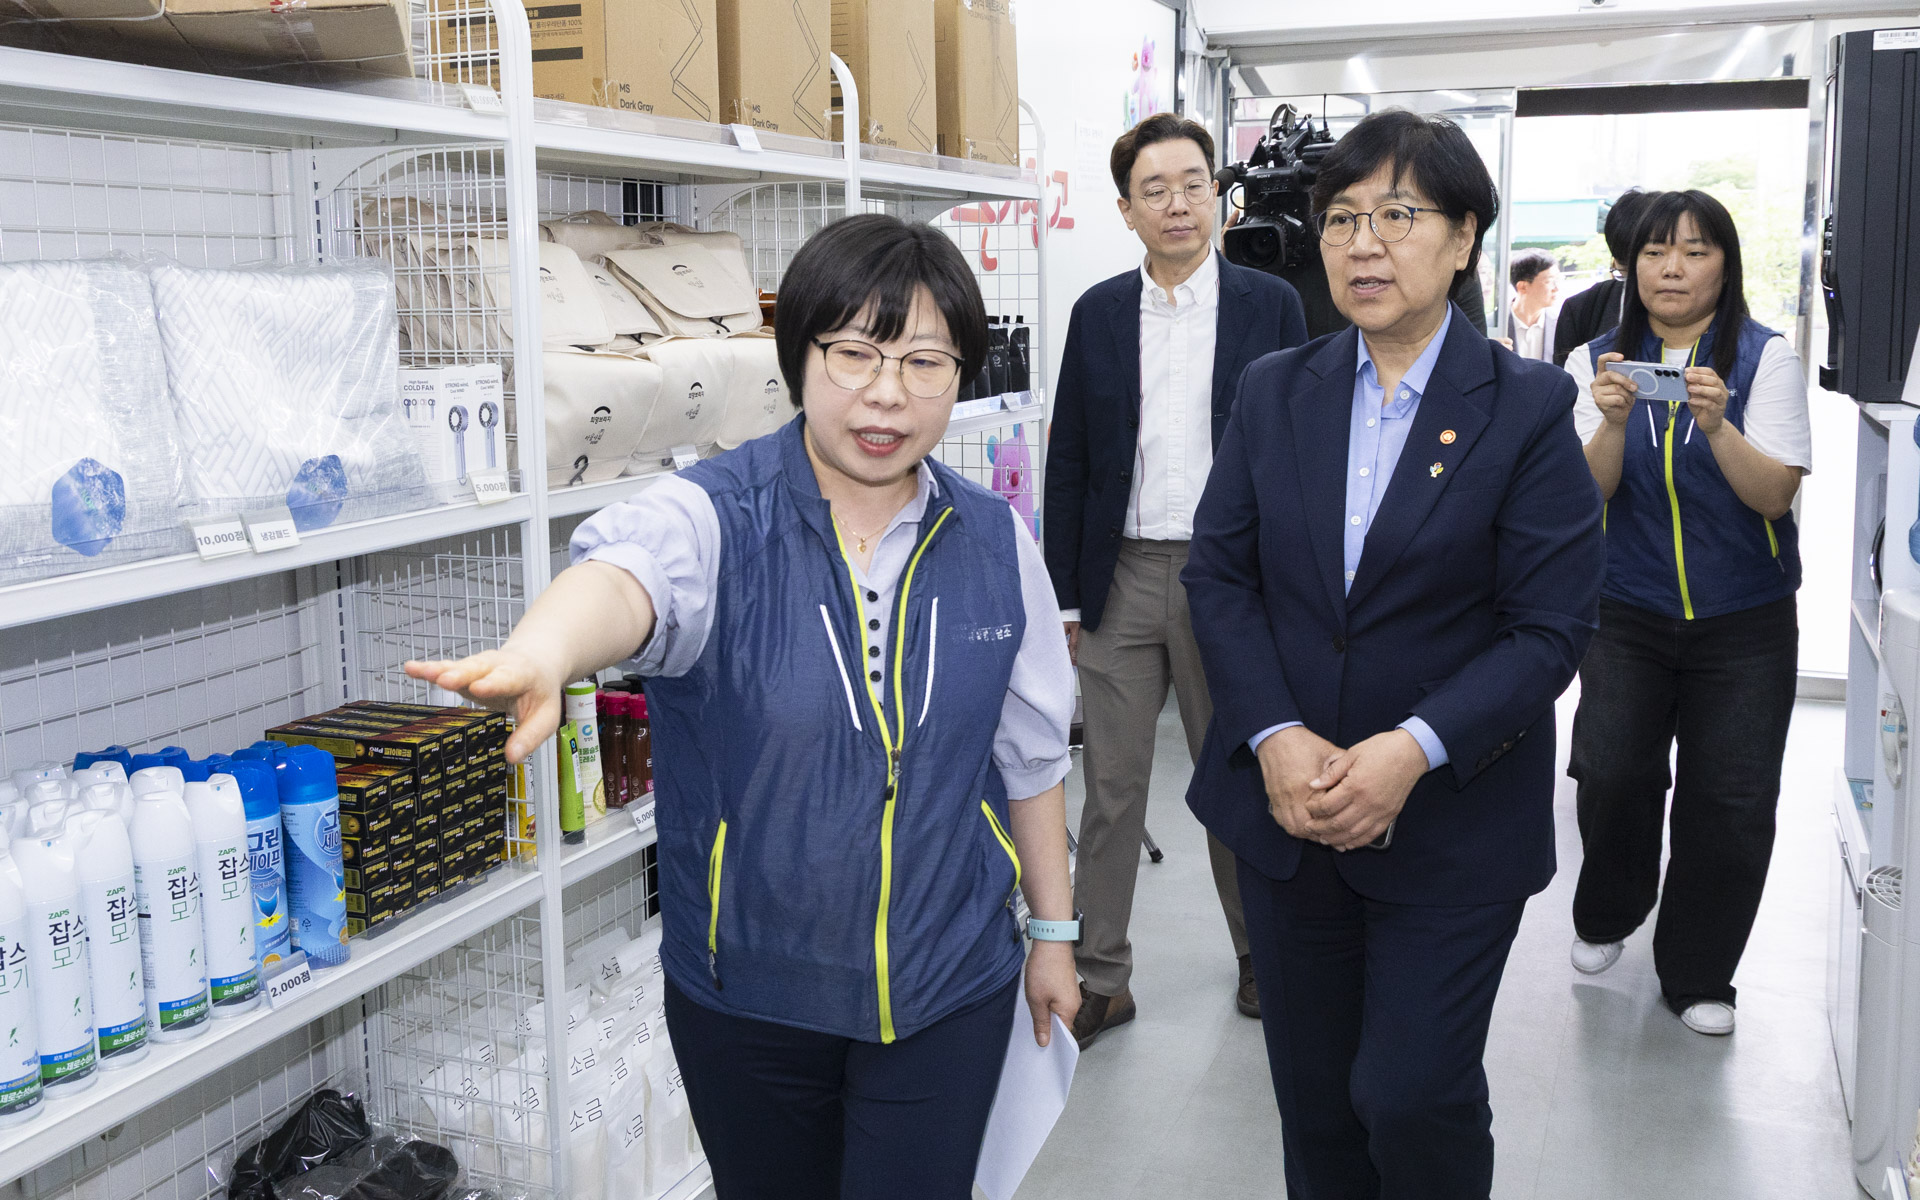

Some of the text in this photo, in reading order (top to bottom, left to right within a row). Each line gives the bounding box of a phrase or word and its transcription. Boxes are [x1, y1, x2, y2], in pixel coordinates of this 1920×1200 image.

[567, 18, 583, 26] 100%
[619, 83, 631, 94] MS
[619, 98, 654, 114] Dark Gray
[752, 104, 761, 114] MS
[752, 117, 779, 132] Dark Gray
[475, 482, 508, 493] 5,000점
[197, 530, 245, 546] 10,000점
[260, 529, 291, 542] 냉감패드
[324, 810, 340, 831] 그
[636, 807, 655, 824] 5,000
[247, 827, 279, 852] 그린
[218, 847, 237, 856] ZAPS
[167, 866, 186, 876] ZAPS
[106, 886, 126, 897] ZAPS
[48, 909, 70, 920] ZAPS
[48, 914, 85, 946] 잡스
[270, 970, 311, 998] 2,000점
[570, 1047, 596, 1076] 소금
[569, 1097, 603, 1133] 소금
[624, 1114, 644, 1149] 소금
